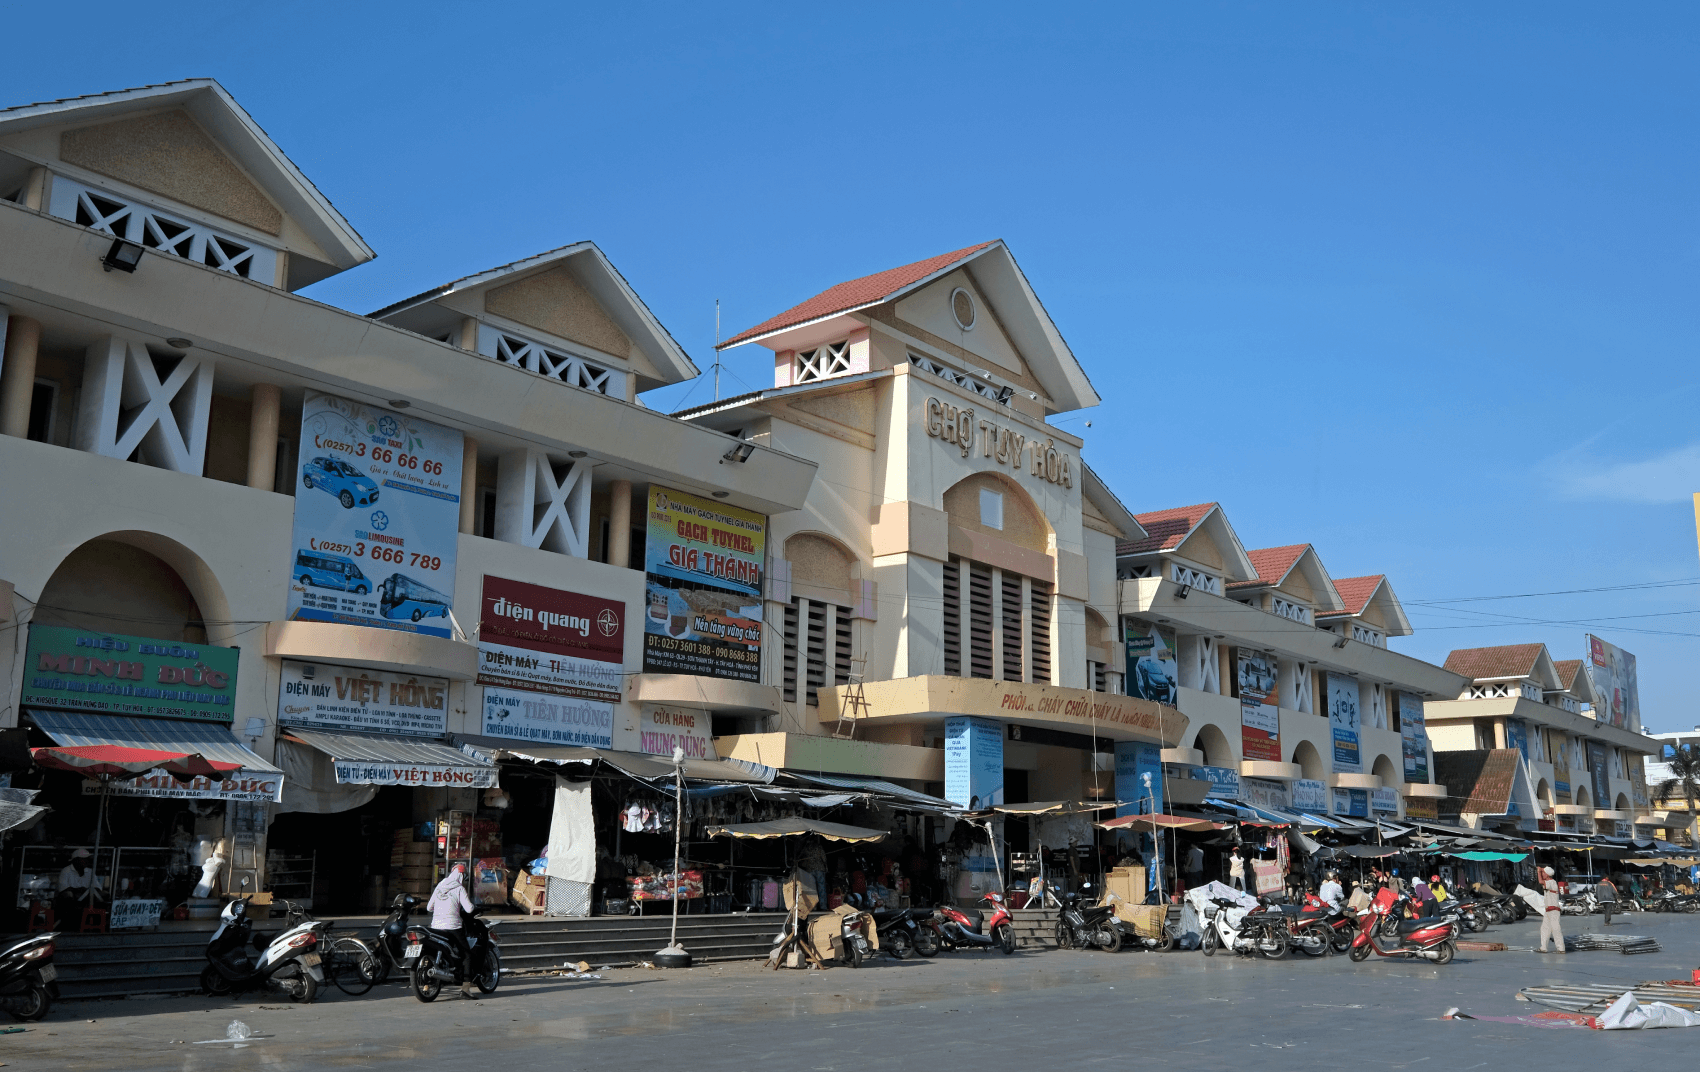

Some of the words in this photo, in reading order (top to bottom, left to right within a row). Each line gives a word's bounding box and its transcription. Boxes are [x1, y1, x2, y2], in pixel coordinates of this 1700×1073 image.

[322, 438, 354, 455] (0257)
[356, 443, 366, 456] 3
[372, 447, 392, 463] 66
[398, 454, 418, 470] 66
[422, 460, 442, 475] 66
[926, 397, 974, 458] CHỢ
[980, 419, 1024, 469] TUY
[1030, 439, 1073, 489] HÒA
[368, 532, 404, 547] LIMOUSINE
[677, 520, 708, 544] GẠCH
[712, 526, 755, 554] TUYNEL
[319, 540, 352, 556] (0257)
[354, 542, 366, 557] 3
[371, 546, 404, 564] 666
[410, 552, 441, 570] 789
[670, 544, 699, 572] GIA
[704, 552, 759, 586] THÀNH
[487, 596, 534, 622] điện
[537, 609, 590, 637] quang
[694, 616, 709, 632] Nền
[710, 618, 726, 638] tảng
[727, 622, 744, 642] vững
[745, 622, 760, 642] chắc
[486, 651, 512, 668] ĐIỆN
[515, 656, 539, 670] MÁY
[648, 635, 660, 647] ĐT:
[662, 638, 678, 650] 0257
[680, 640, 697, 653] 3601
[698, 643, 710, 656] 388
[716, 646, 728, 657] 090
[729, 647, 745, 660] 8686
[746, 650, 758, 663] 388
[38, 652, 145, 682] MINH
[157, 661, 230, 689] ĐỨC
[286, 681, 309, 697] ĐIỆN
[312, 683, 331, 698] MÁY
[334, 674, 384, 707] VIỆT
[390, 676, 444, 710] HỒNG
[486, 694, 504, 706] ĐIỆN
[505, 696, 520, 707] MÁY
[523, 699, 557, 722] TIÊN
[561, 702, 610, 728] HƯỞNG
[654, 708, 670, 725] CỬA
[673, 711, 695, 728] HÀNG
[1038, 695, 1064, 714] CHÁY
[1065, 696, 1088, 717] CHỮA
[1089, 702, 1111, 720] CHÁY
[486, 722, 504, 735] CHUYÊN
[504, 723, 513, 736] BÁN
[530, 728, 541, 740] QUẠT
[641, 731, 676, 754] NHUNG
[679, 730, 706, 758] DŨNG
[136, 776, 212, 791] MINH
[222, 778, 276, 794] ĐỨC
[352, 767, 360, 780] TỬ
[393, 767, 429, 784] VIỆT
[432, 768, 473, 783] HỒNG
